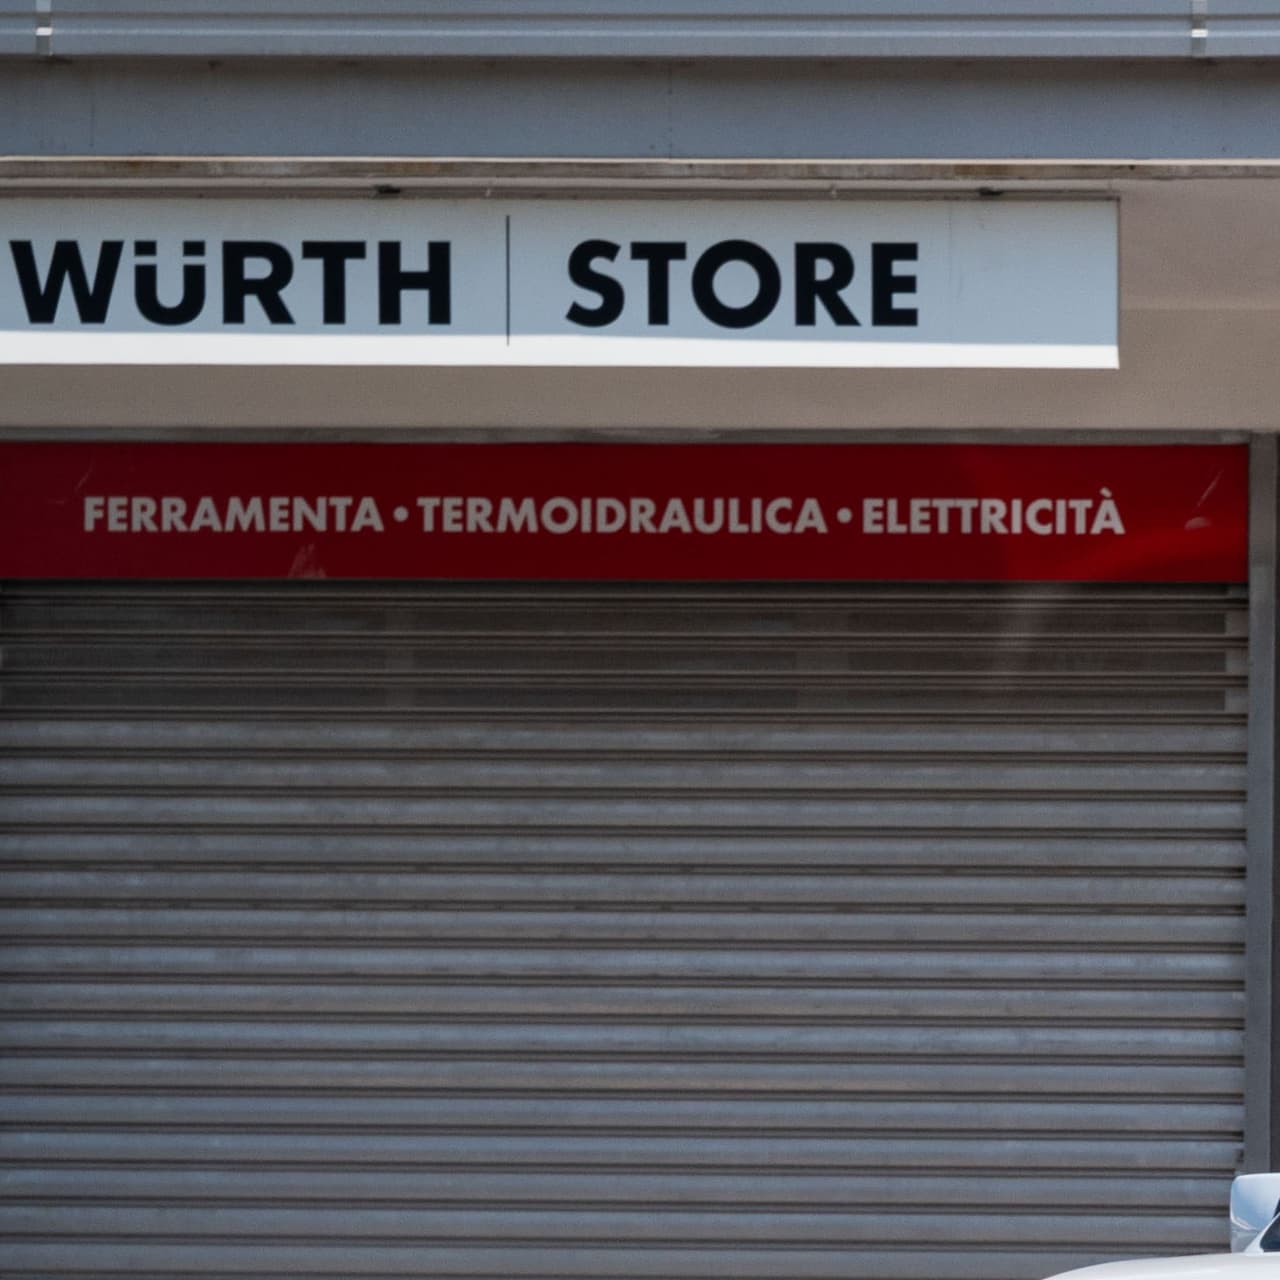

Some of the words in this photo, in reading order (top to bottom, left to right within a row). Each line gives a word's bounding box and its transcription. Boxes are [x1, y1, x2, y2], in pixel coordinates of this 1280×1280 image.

[8, 239, 452, 326] WÜRTH
[565, 239, 919, 329] STORE
[84, 496, 384, 532] FERRAMENTA
[417, 496, 828, 534] TERMOIDRAULICA
[863, 487, 1126, 535] ELETTRICITÀ
